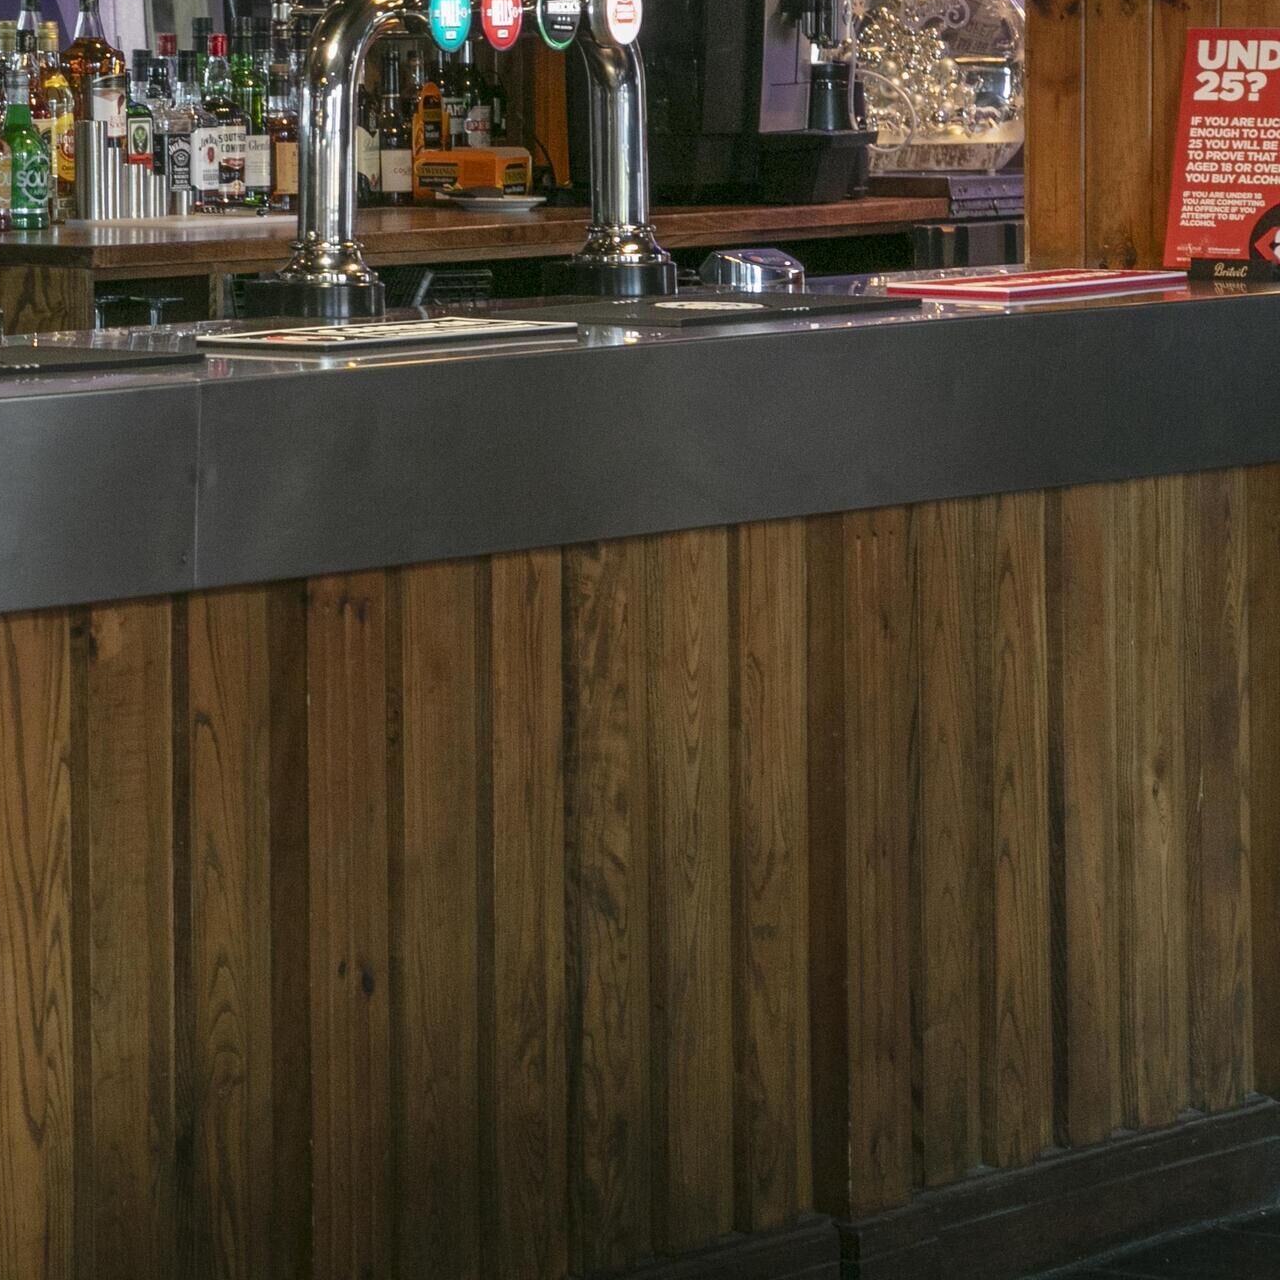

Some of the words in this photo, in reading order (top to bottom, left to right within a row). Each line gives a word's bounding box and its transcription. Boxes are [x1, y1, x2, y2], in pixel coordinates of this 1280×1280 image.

[1193, 71, 1268, 102] 25?
[1191, 116, 1203, 126] IF
[1204, 116, 1228, 127] YOU
[1230, 117, 1255, 127] ARE
[1189, 128, 1240, 138] ENOUGH
[1242, 128, 1258, 138] TO
[1188, 139, 1203, 149] 25
[1205, 139, 1230, 149] YOU
[1232, 140, 1261, 150] WILL
[1262, 141, 1278, 150] BE
[1187, 150, 1204, 160] TO
[1206, 151, 1245, 161] PROVE
[1247, 152, 1278, 162] THAT
[1186, 162, 1218, 172] AGED
[1220, 163, 1233, 172] 18
[1235, 163, 1252, 173] OR
[1185, 173, 1210, 183] YOU
[1211, 173, 1236, 184] BUY
[1216, 199, 1266, 207] COMMITTING
